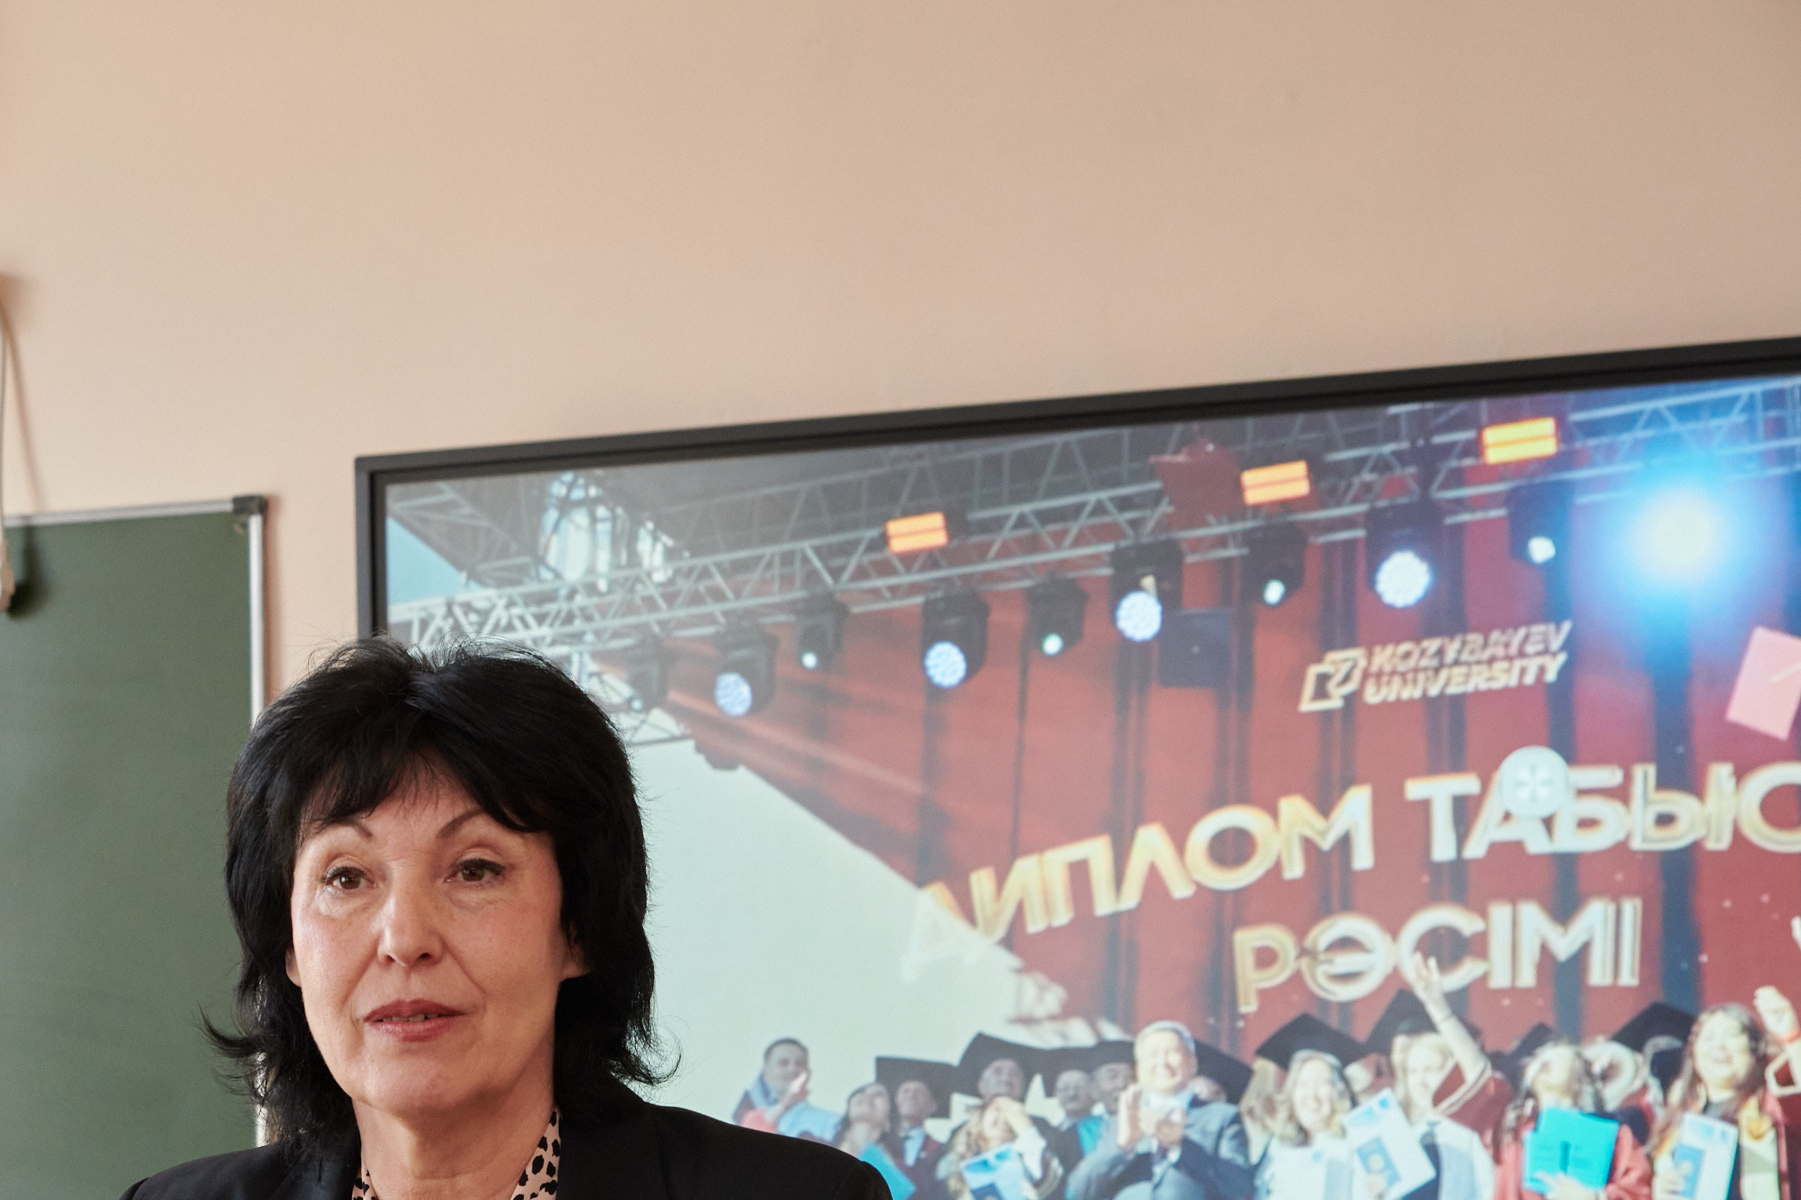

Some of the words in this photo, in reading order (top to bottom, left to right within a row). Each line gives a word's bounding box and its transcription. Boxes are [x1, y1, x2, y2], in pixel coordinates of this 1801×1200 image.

[1367, 620, 1572, 673] KOZYBAYEV
[1363, 651, 1568, 704] UNIVERSITY
[1233, 897, 1644, 1013] РӘСІМІ
